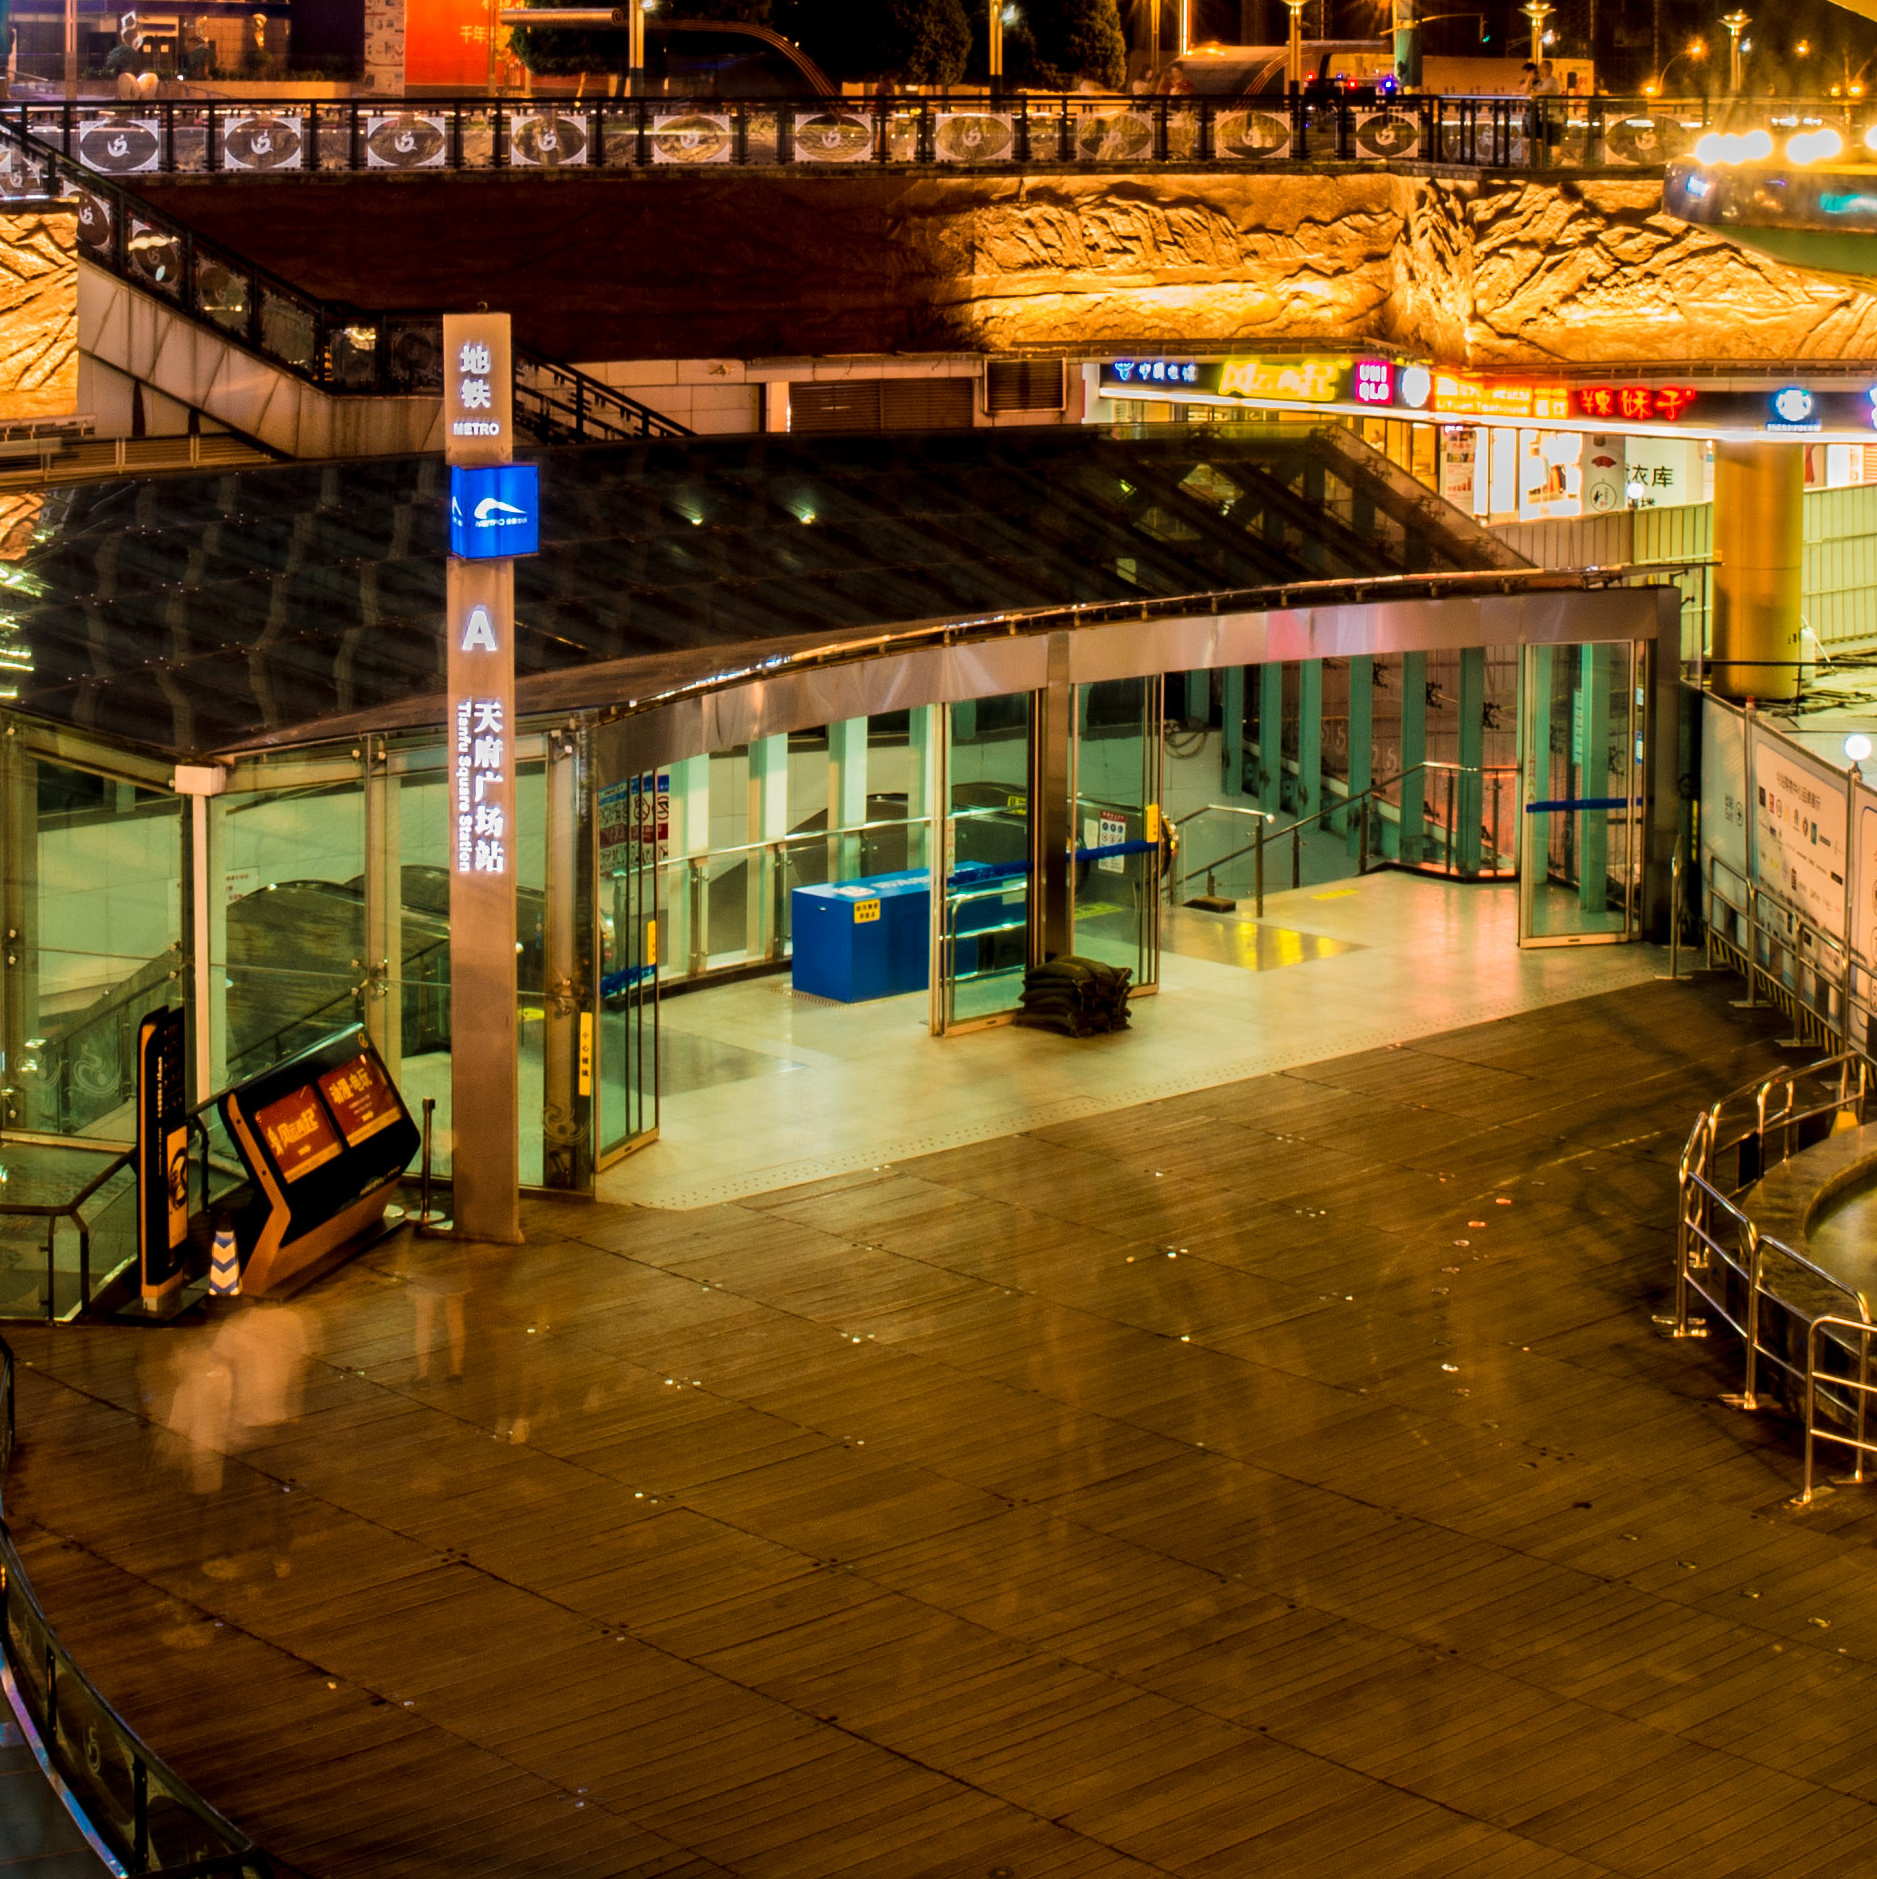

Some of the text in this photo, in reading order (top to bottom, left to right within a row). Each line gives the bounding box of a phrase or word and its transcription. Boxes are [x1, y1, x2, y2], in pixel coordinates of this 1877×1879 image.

[460, 344, 491, 409] 地铁
[1359, 364, 1388, 383] UNI
[1358, 383, 1390, 402] QLO
[1581, 387, 1685, 421] 辣妹子
[1476, 401, 1529, 414] Teahouse
[453, 422, 500, 436] METRO
[1625, 463, 1674, 488] 衣库
[461, 609, 497, 651] A
[456, 701, 472, 872] Tianfu Square Station
[474, 702, 504, 873] 天府广场站
